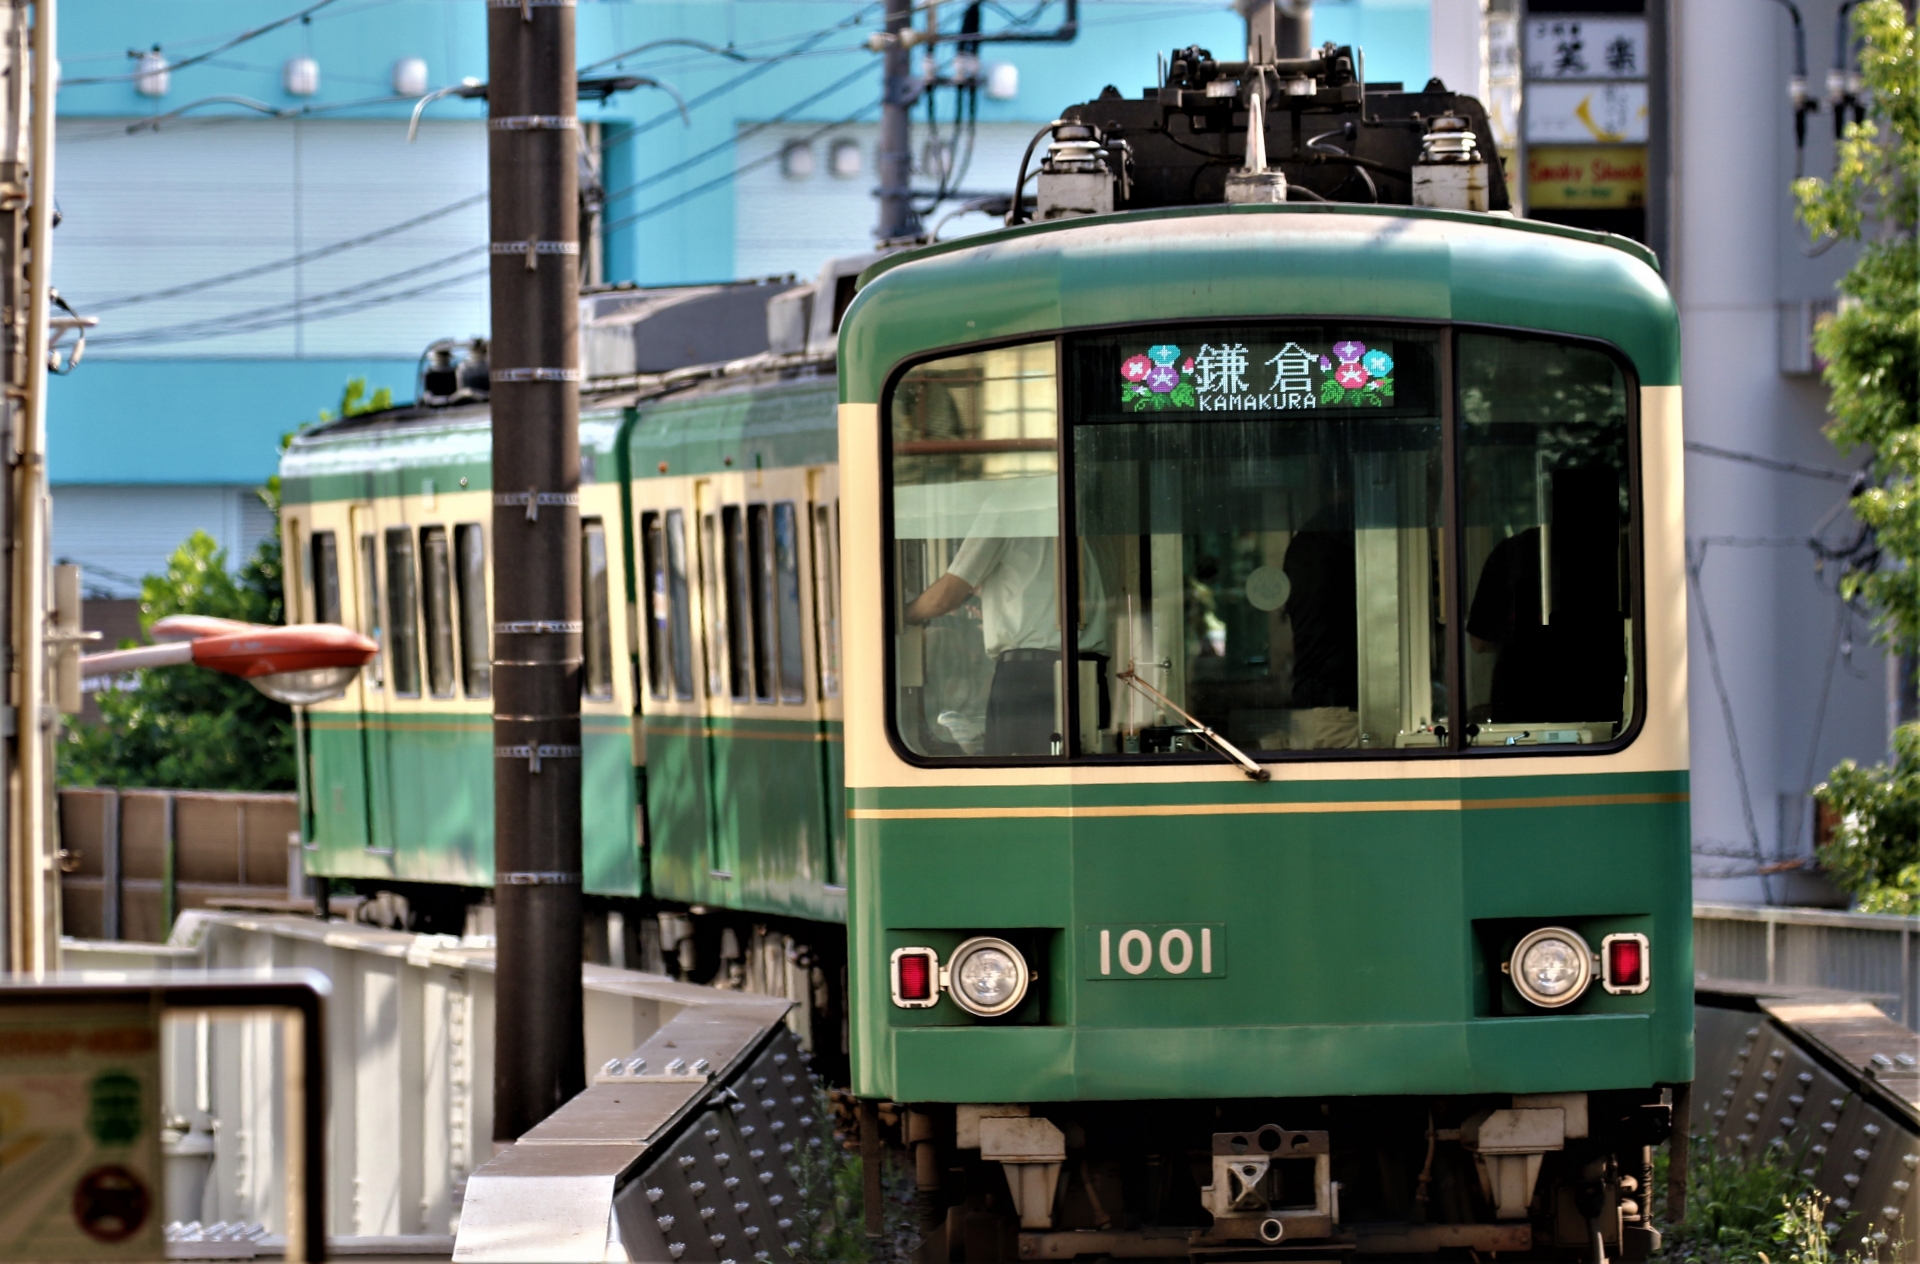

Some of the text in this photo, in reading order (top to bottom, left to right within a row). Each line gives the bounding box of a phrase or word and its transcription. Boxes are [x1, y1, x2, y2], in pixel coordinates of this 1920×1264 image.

[1196, 341, 1319, 394] 鎌倉
[1199, 392, 1316, 411] KAMAKURA
[1100, 927, 1212, 975] 1001
